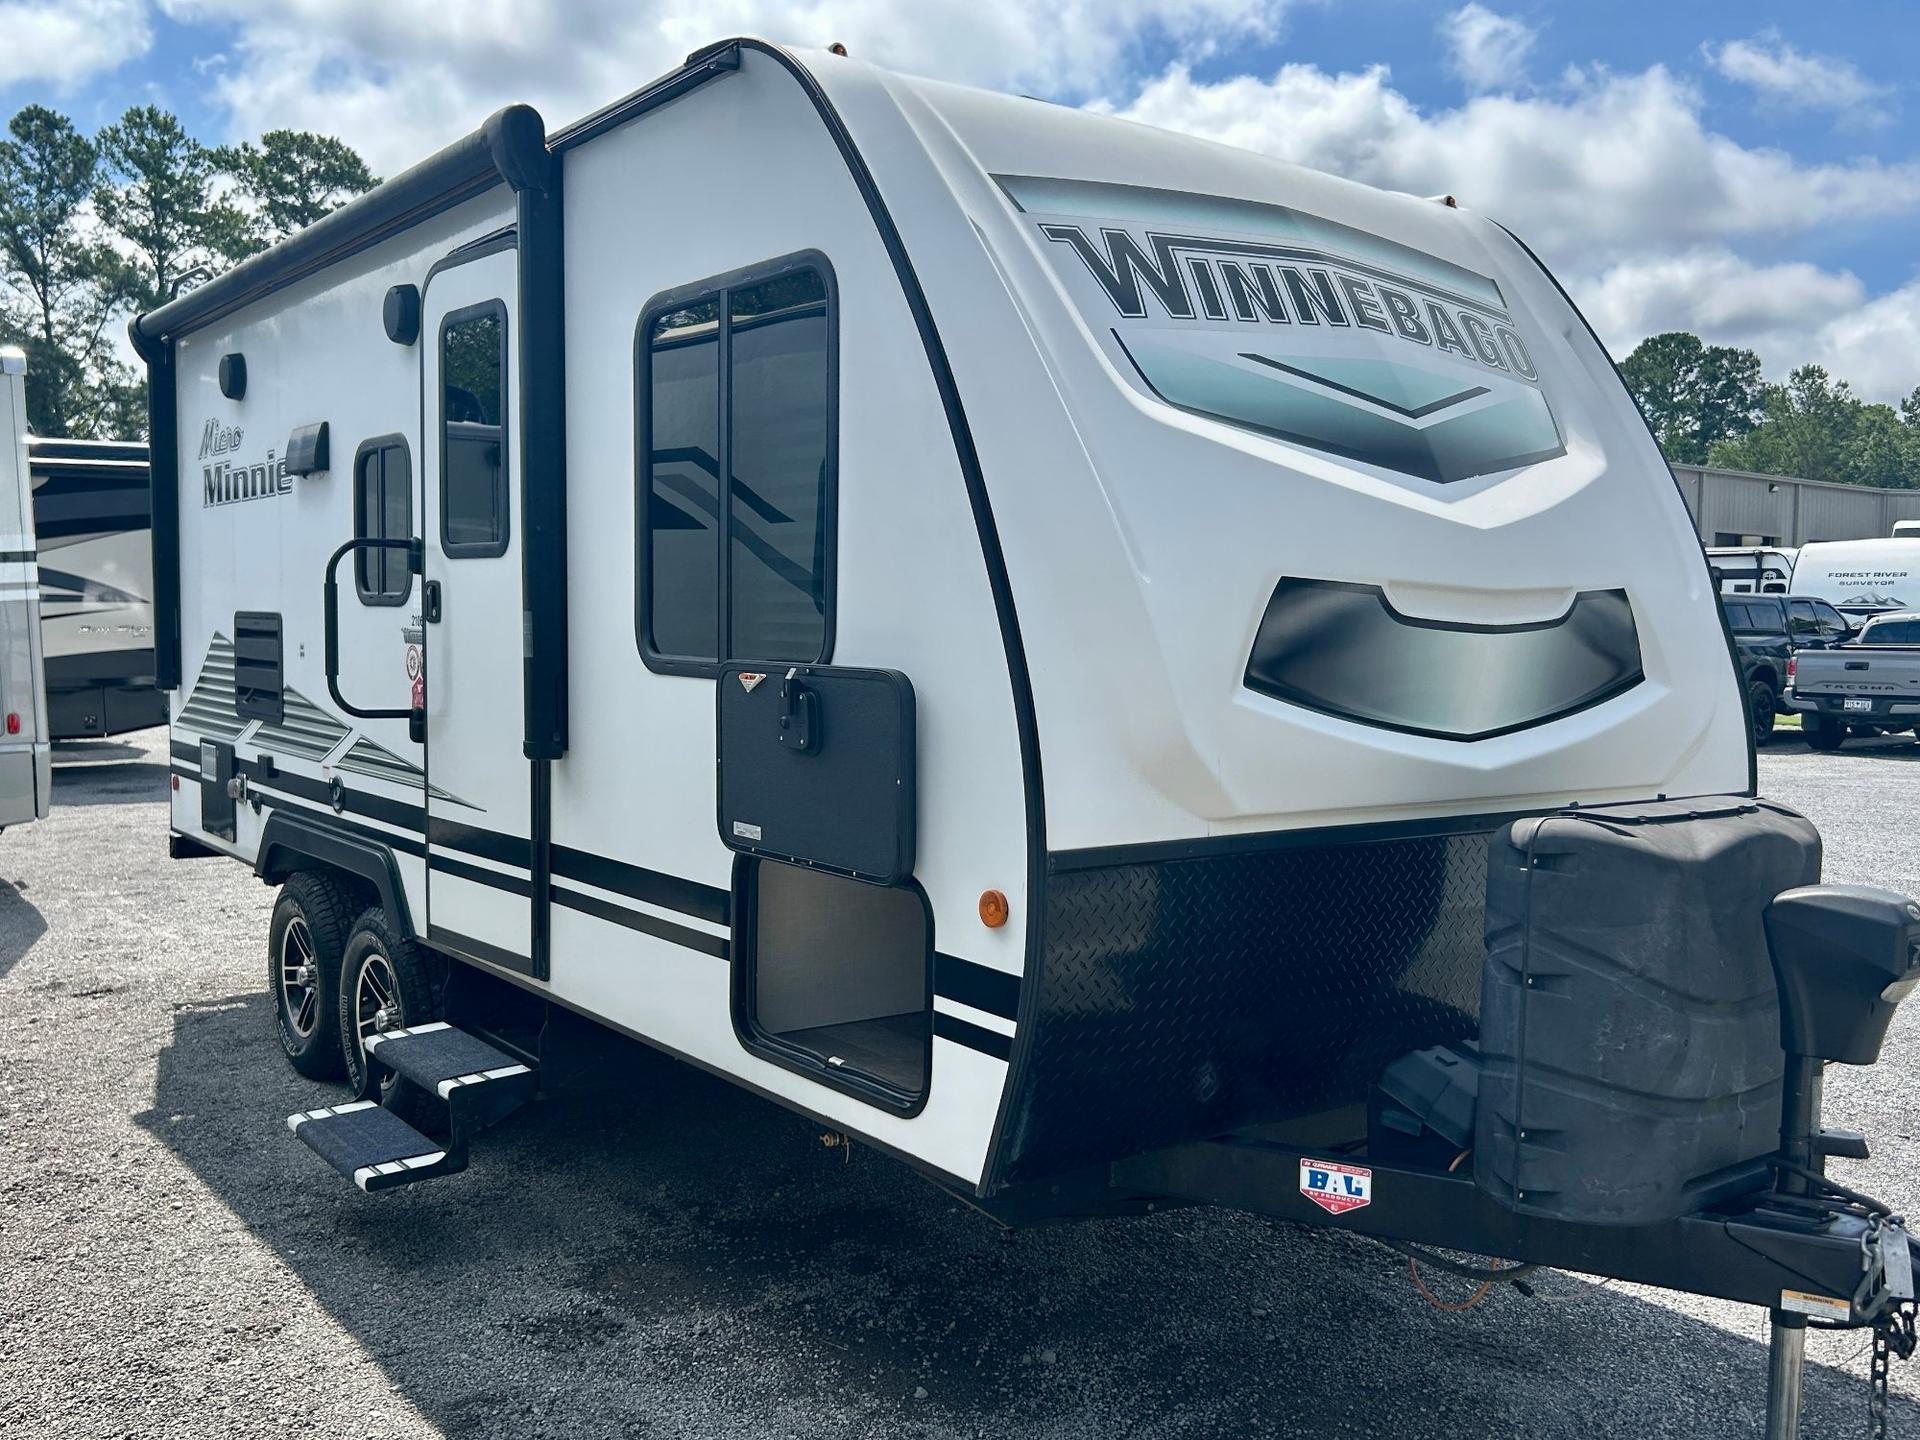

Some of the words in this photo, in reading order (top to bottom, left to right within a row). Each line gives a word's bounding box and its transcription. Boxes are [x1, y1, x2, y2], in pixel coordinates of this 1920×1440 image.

[1038, 223, 1538, 383] WINNEBAGO
[203, 449, 293, 508] Minnie
[1307, 1169, 1363, 1197] BAL
